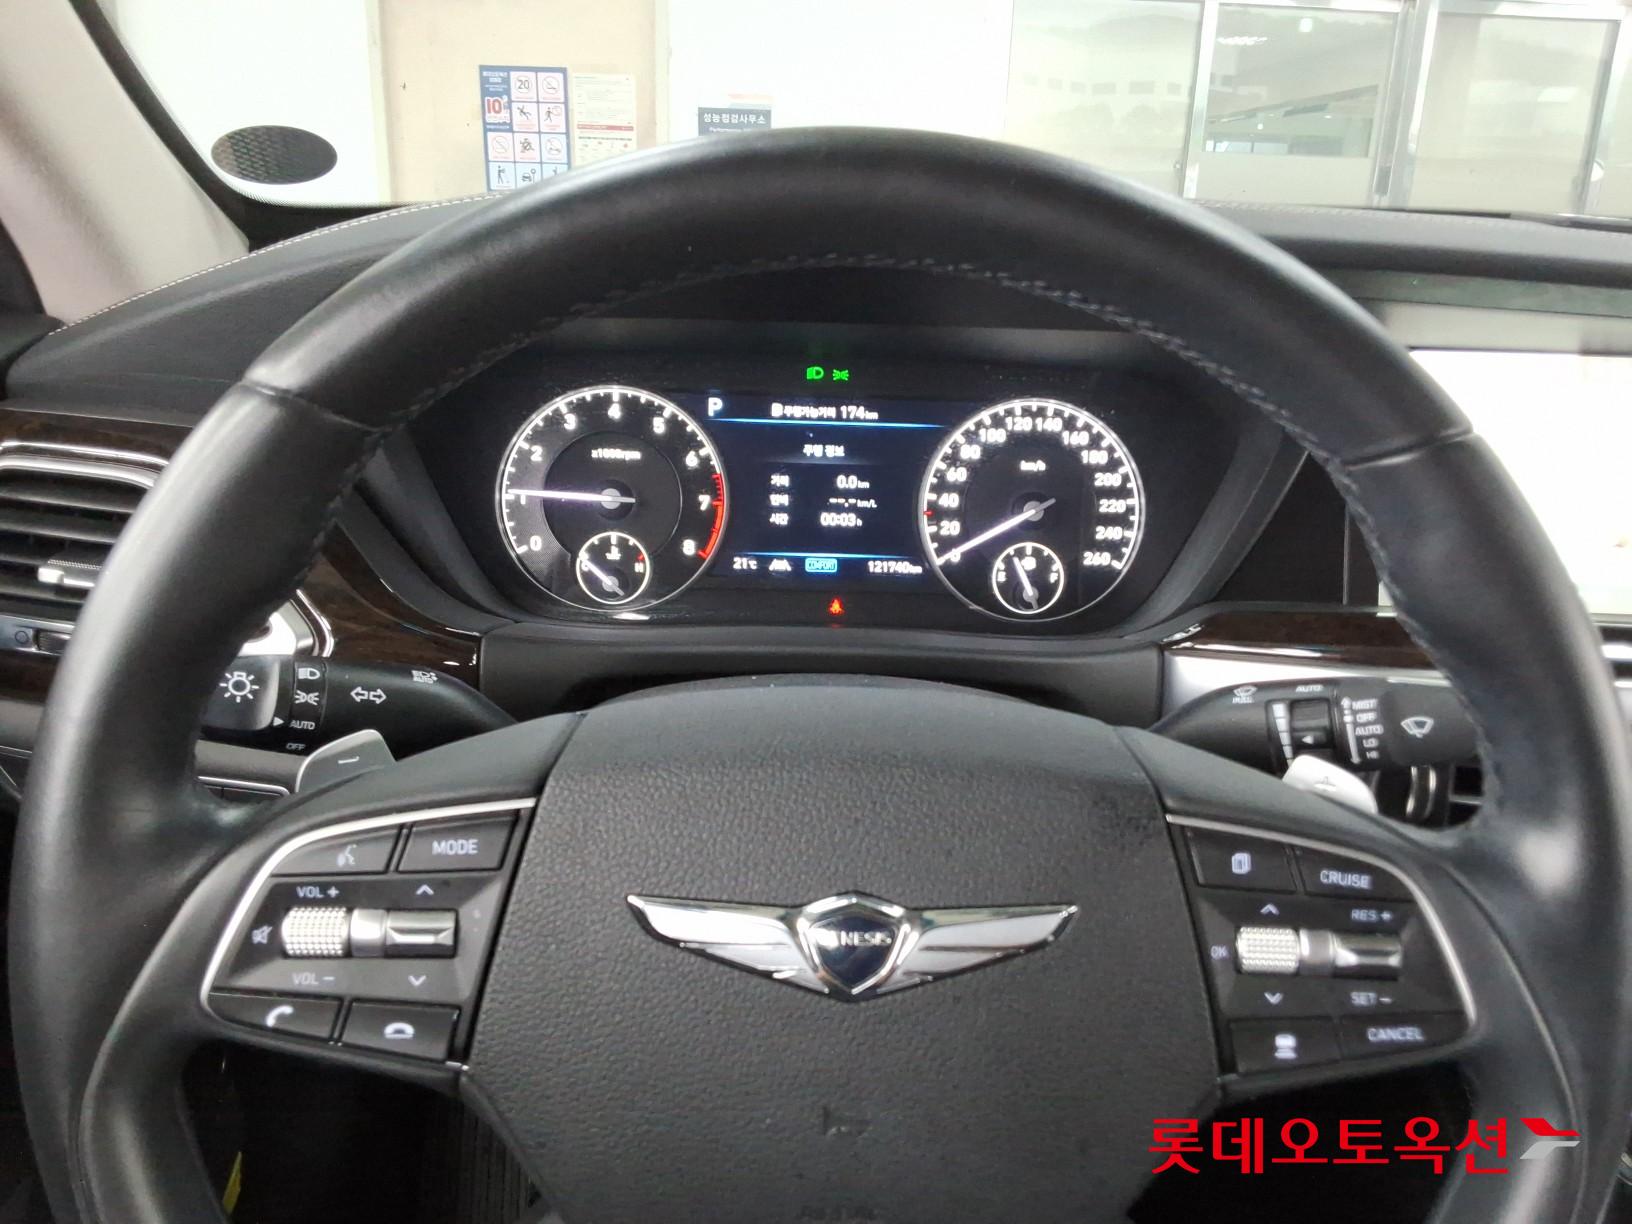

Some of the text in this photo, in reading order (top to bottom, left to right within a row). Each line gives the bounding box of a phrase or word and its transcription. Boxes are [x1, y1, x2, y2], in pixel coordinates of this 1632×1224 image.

[517, 79, 529, 90] 20
[704, 112, 766, 124] 성능점검사무소
[607, 403, 621, 419] 4
[708, 398, 723, 416] P
[564, 415, 577, 430] 3
[653, 418, 665, 433] 5
[1006, 416, 1032, 431] 120
[1036, 417, 1063, 432] 140
[979, 428, 1006, 443] 100
[1062, 431, 1089, 446] 160
[530, 446, 542, 461] 2
[960, 444, 981, 459] 80
[1081, 450, 1108, 464] 180
[685, 453, 698, 467] 6
[947, 467, 967, 482] 60
[1095, 472, 1122, 486] 200
[698, 495, 711, 511] 7
[938, 493, 959, 508] 40
[1099, 499, 1126, 513] 220
[940, 521, 960, 535] 20
[1095, 526, 1123, 540] 240
[530, 536, 542, 551] 0
[683, 540, 695, 555] 8
[1083, 552, 1111, 566] 260
[1295, 684, 1324, 693] AUTO
[1352, 698, 1378, 710] MIST
[1356, 712, 1377, 722] OFF
[290, 719, 315, 730] AUTO
[1355, 725, 1384, 735] AUTO
[286, 742, 305, 751] OFF
[432, 839, 478, 855] MODE
[1319, 869, 1372, 889] CRUISE
[296, 886, 324, 898] VOL
[1351, 909, 1378, 922] RES
[1211, 945, 1228, 959] OK
[292, 973, 318, 985] VOL
[1350, 992, 1377, 1006] SET
[1366, 1026, 1425, 1043] CANCEL
